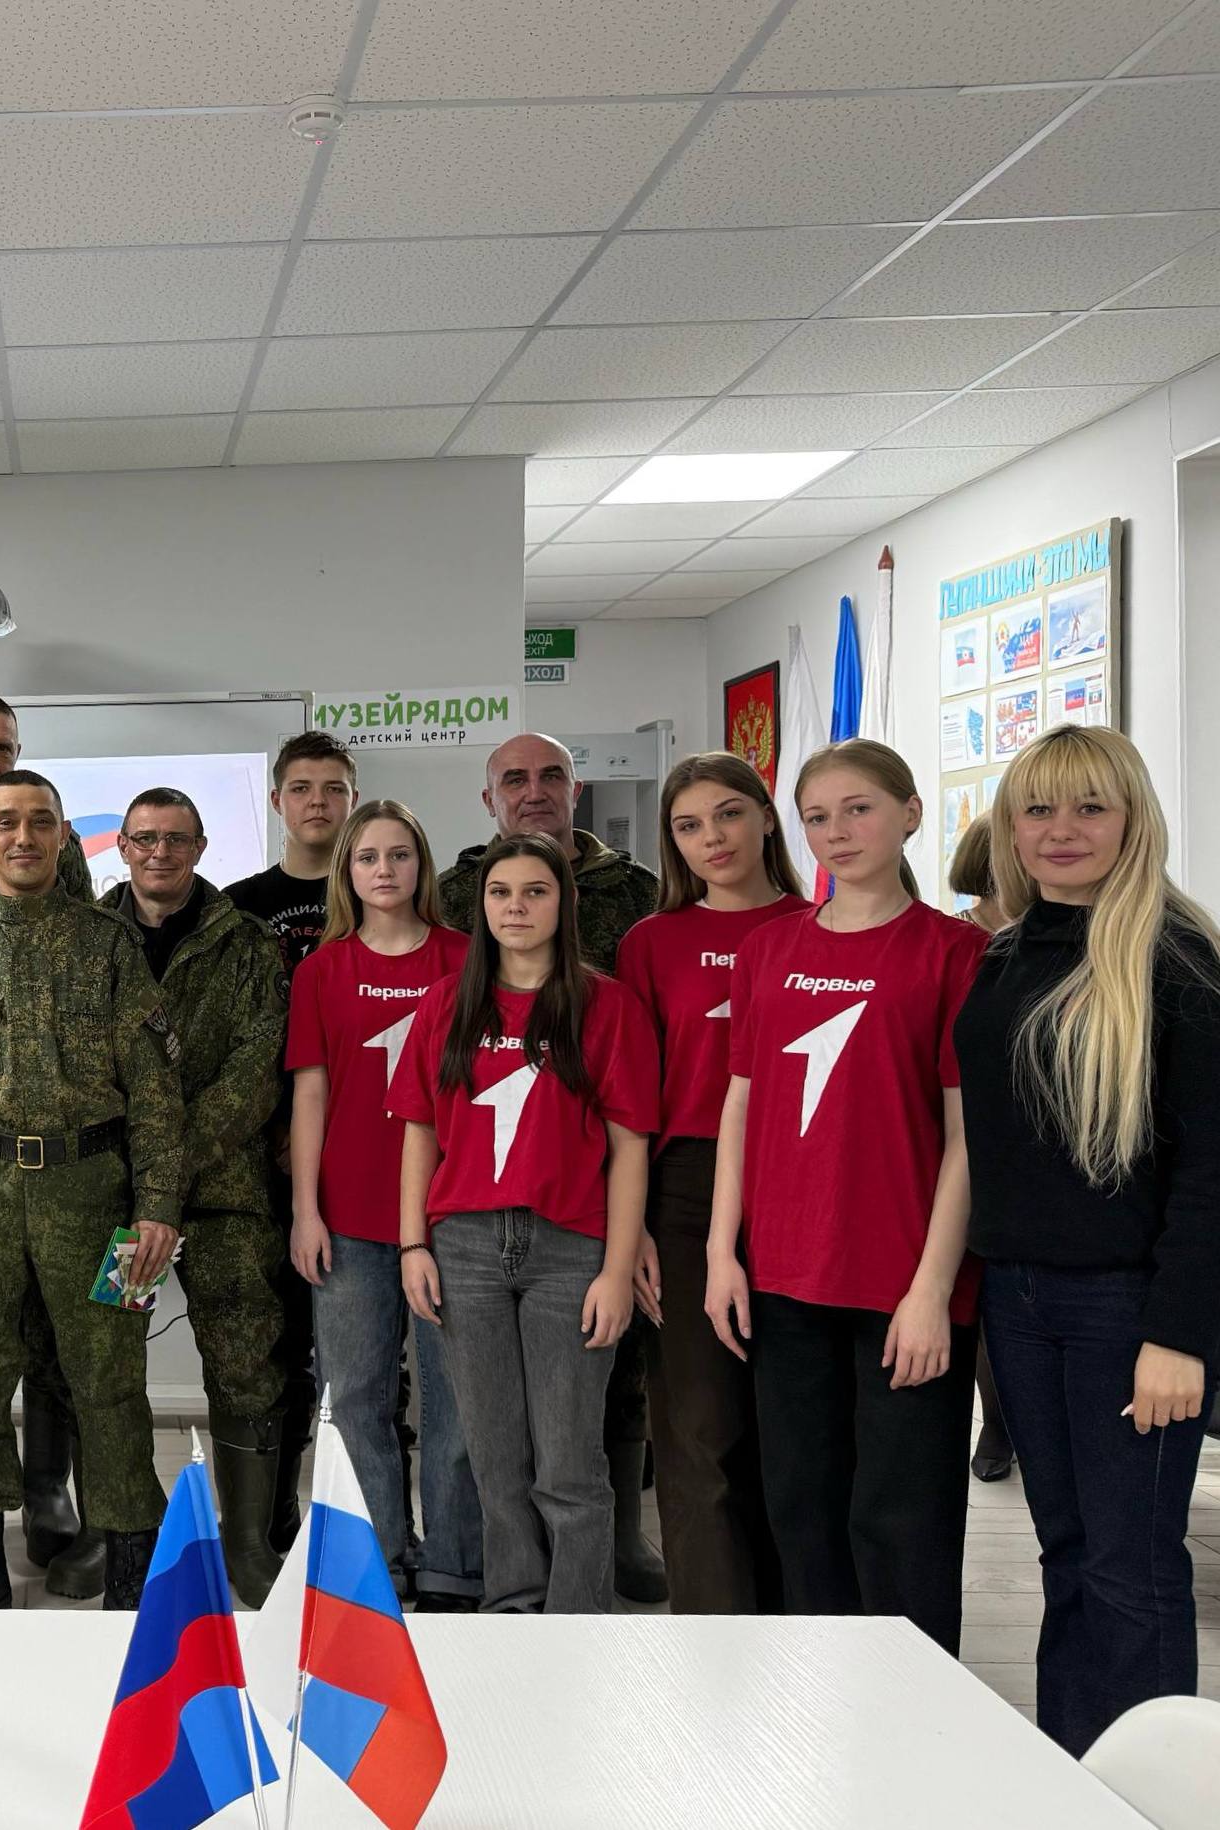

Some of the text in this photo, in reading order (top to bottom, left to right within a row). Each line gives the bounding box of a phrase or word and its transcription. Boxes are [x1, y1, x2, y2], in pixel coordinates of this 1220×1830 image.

[524, 633, 554, 646] ЫХОД
[348, 728, 466, 746] детский центр
[784, 973, 875, 996] Первые
